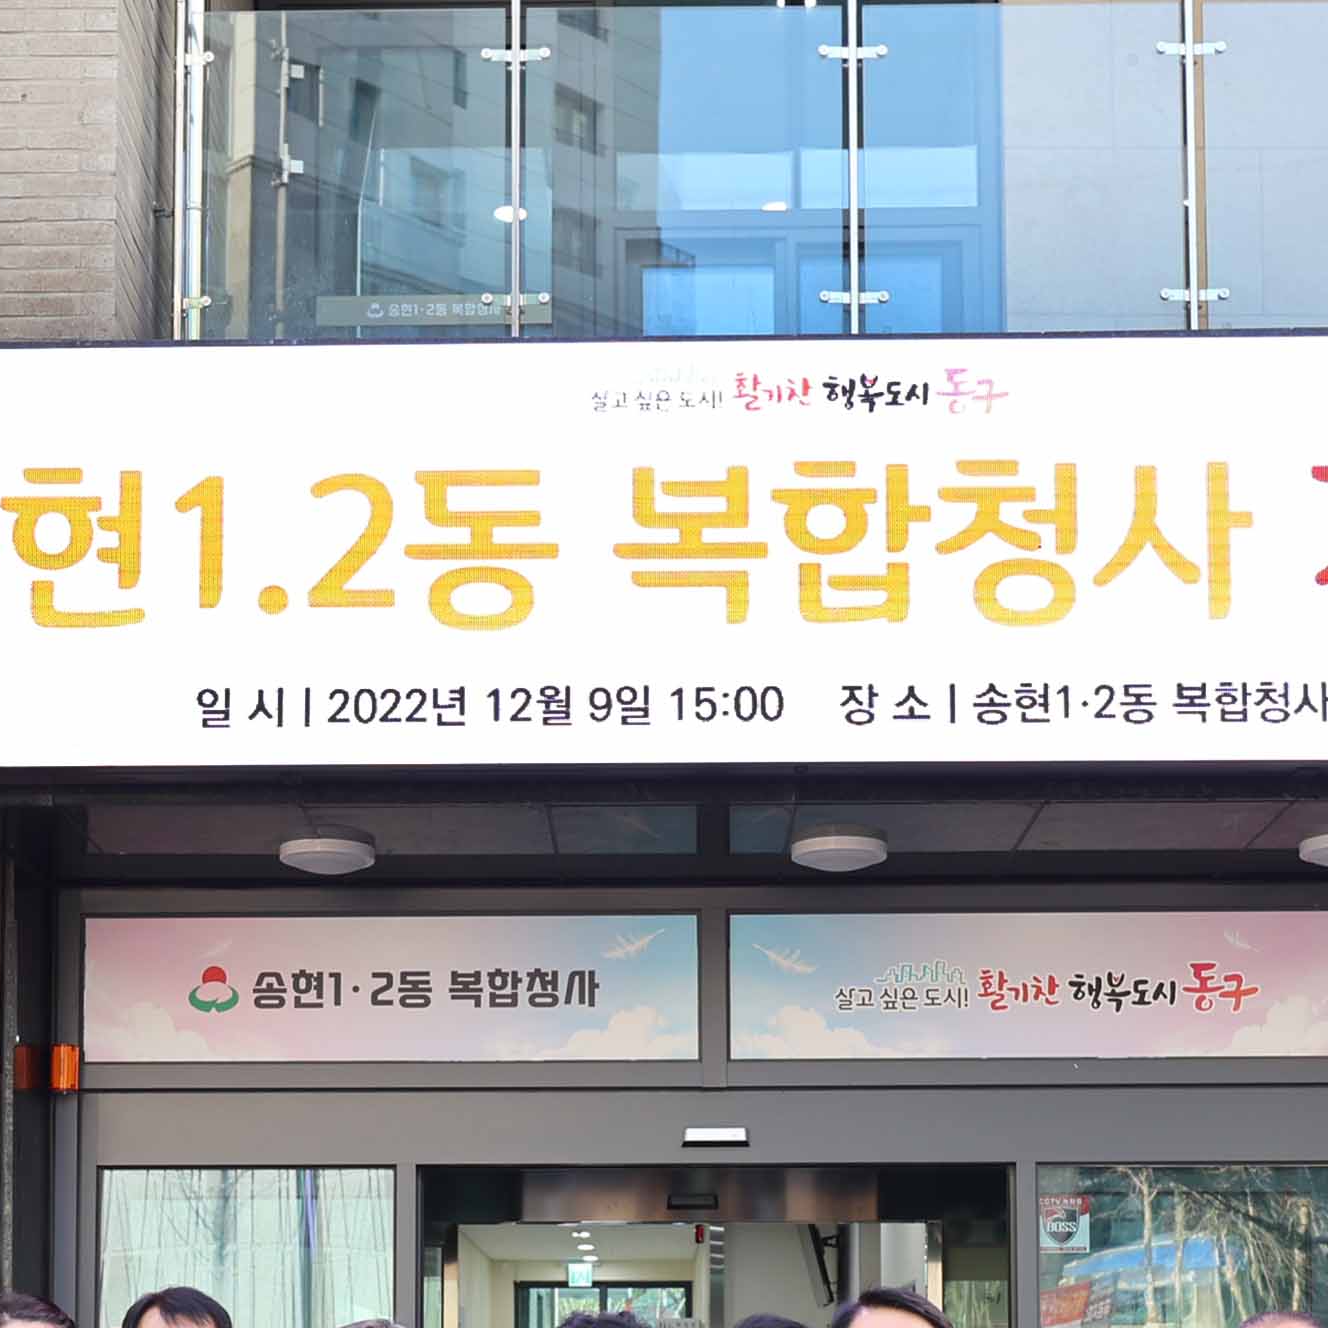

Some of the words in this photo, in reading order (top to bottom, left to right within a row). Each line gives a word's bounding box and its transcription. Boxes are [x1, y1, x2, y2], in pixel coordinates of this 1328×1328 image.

[732, 373, 812, 411] 활기찬
[822, 374, 931, 414] 행복도시
[936, 369, 1009, 414] 동구
[613, 460, 1254, 628] 복합청사
[328, 687, 467, 728] 2022년
[488, 686, 573, 727] 12월
[590, 686, 651, 727] 9일
[671, 686, 785, 723] 15:00
[973, 683, 1158, 727] 송현1·2동
[253, 970, 434, 1010] 송현1·2동
[449, 968, 601, 1010] 복합청사
[835, 988, 875, 1012] 살고
[880, 988, 919, 1012] 싶은
[924, 988, 970, 1010] 도시!
[977, 970, 1061, 1012] 활기찬
[1068, 973, 1177, 1012] 행복도시
[1182, 962, 1260, 1012] 동구
